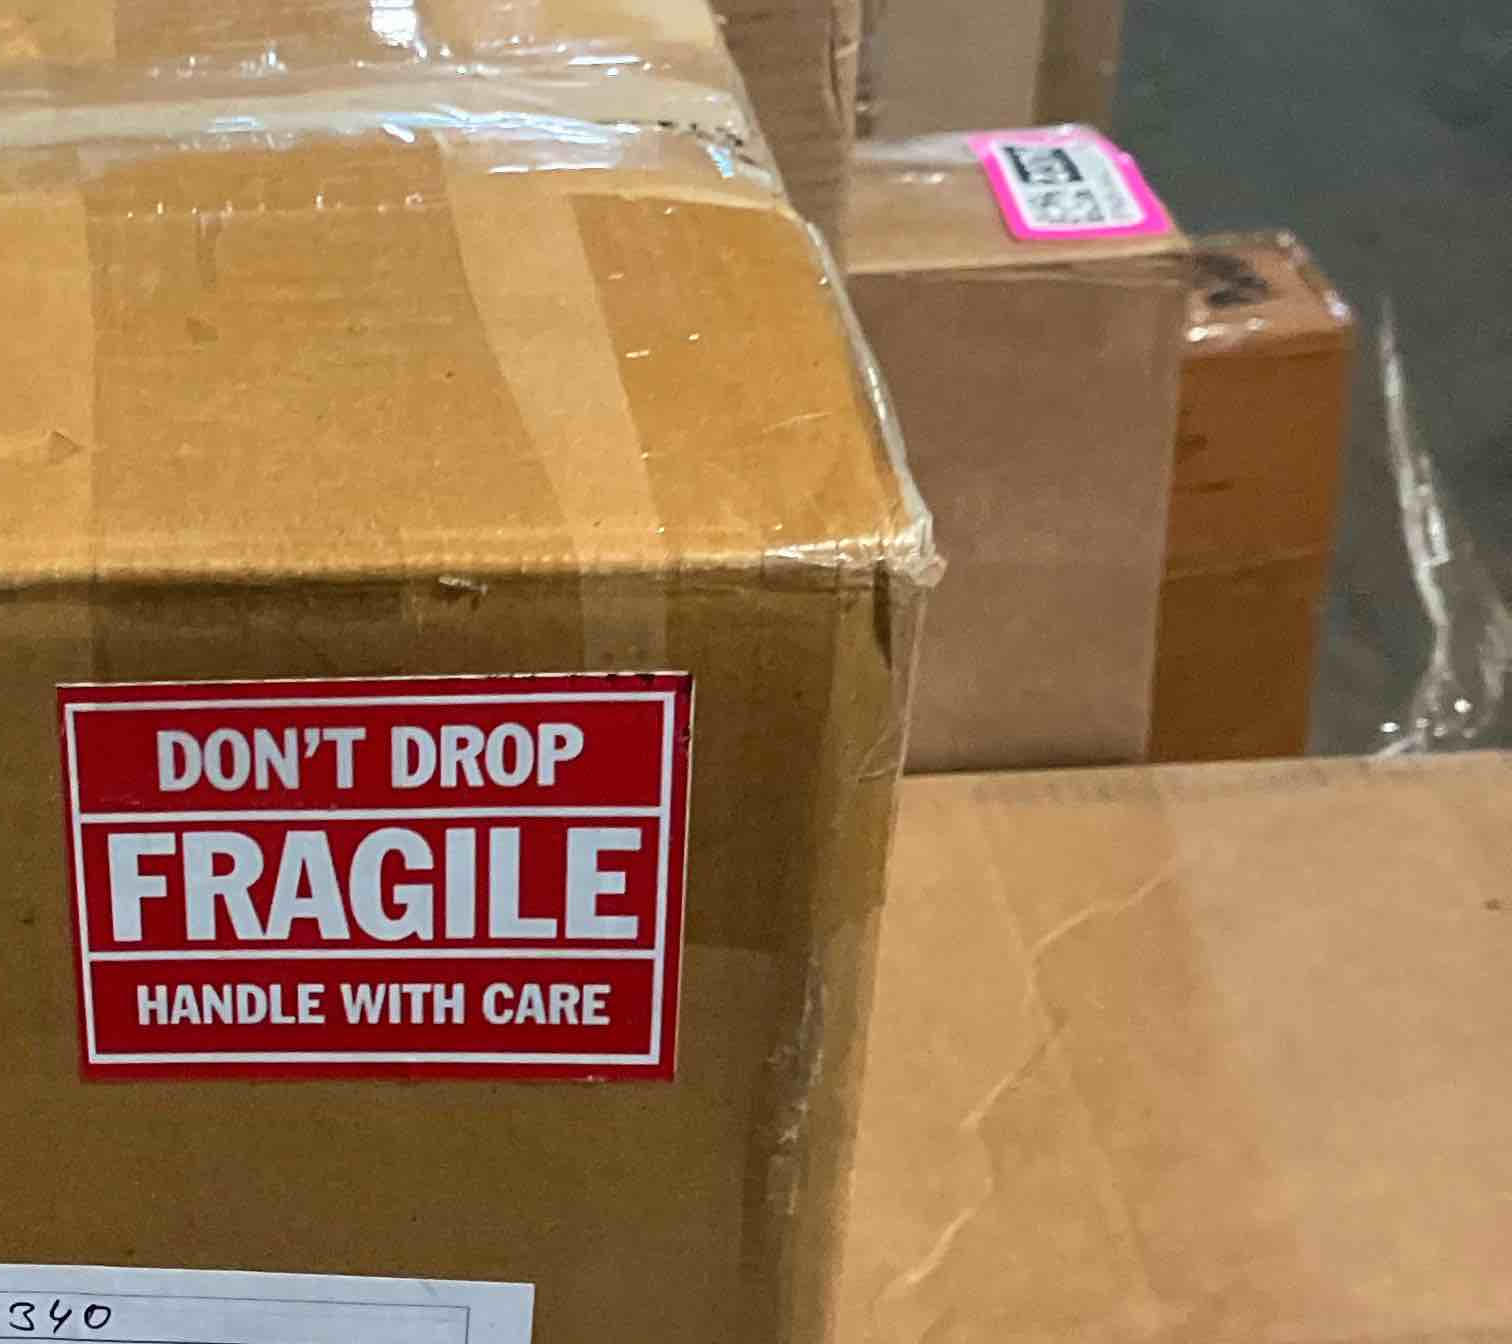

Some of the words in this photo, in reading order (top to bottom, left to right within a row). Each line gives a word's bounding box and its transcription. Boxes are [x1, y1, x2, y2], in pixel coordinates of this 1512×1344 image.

[157, 727, 367, 792] DON'T
[390, 722, 585, 788] DROP
[107, 827, 642, 943] FRAGILE
[136, 982, 326, 1026] HANDLE
[340, 982, 465, 1025] WITH
[482, 983, 612, 1026] CARE
[7, 1299, 112, 1334] 340
